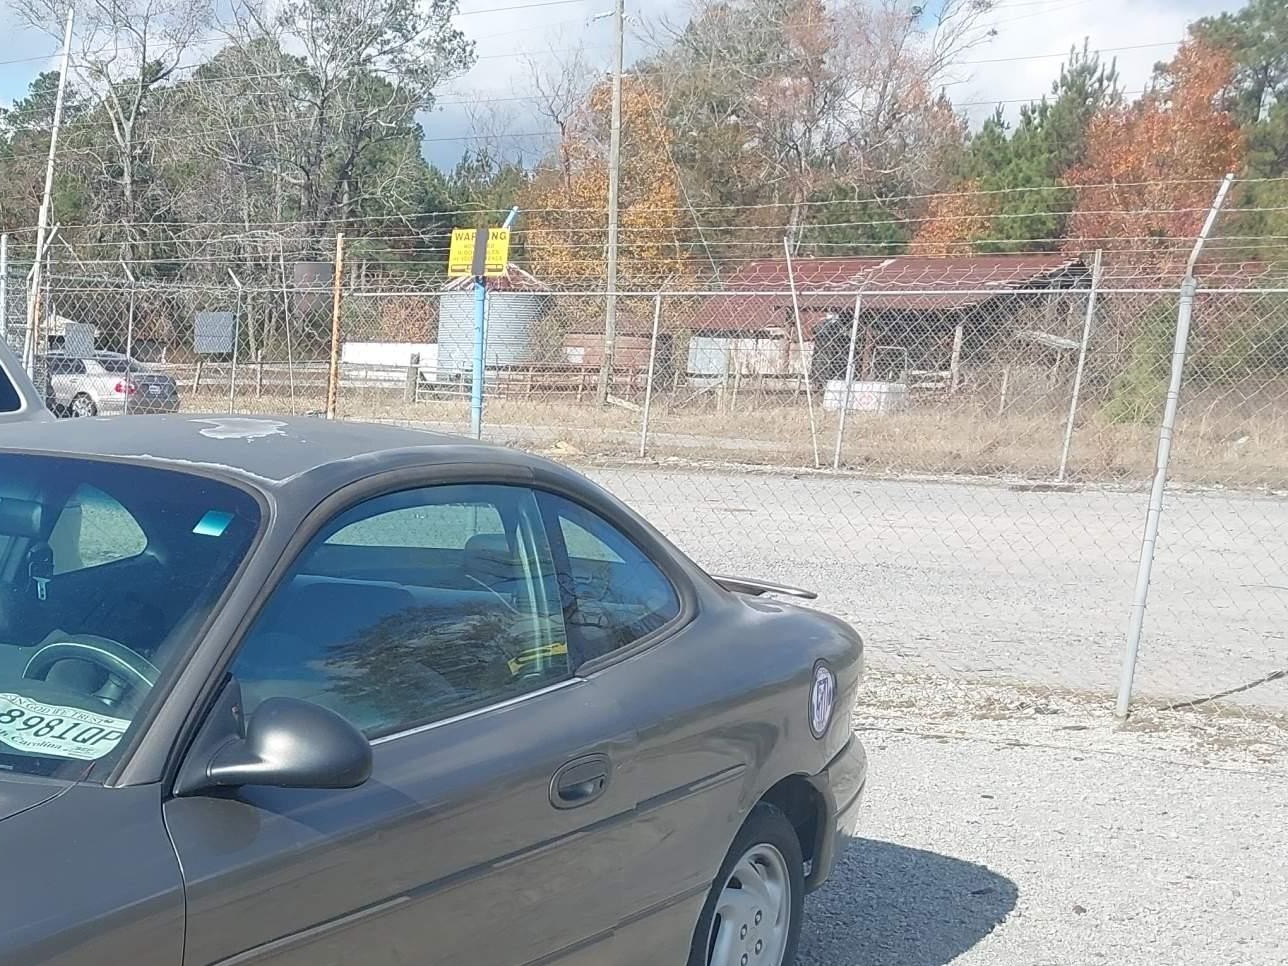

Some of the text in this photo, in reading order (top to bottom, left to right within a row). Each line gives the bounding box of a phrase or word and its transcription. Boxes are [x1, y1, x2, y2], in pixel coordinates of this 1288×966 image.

[455, 231, 507, 241] WARNG
[26, 703, 51, 714] GOD
[11, 735, 63, 749] Carolina
